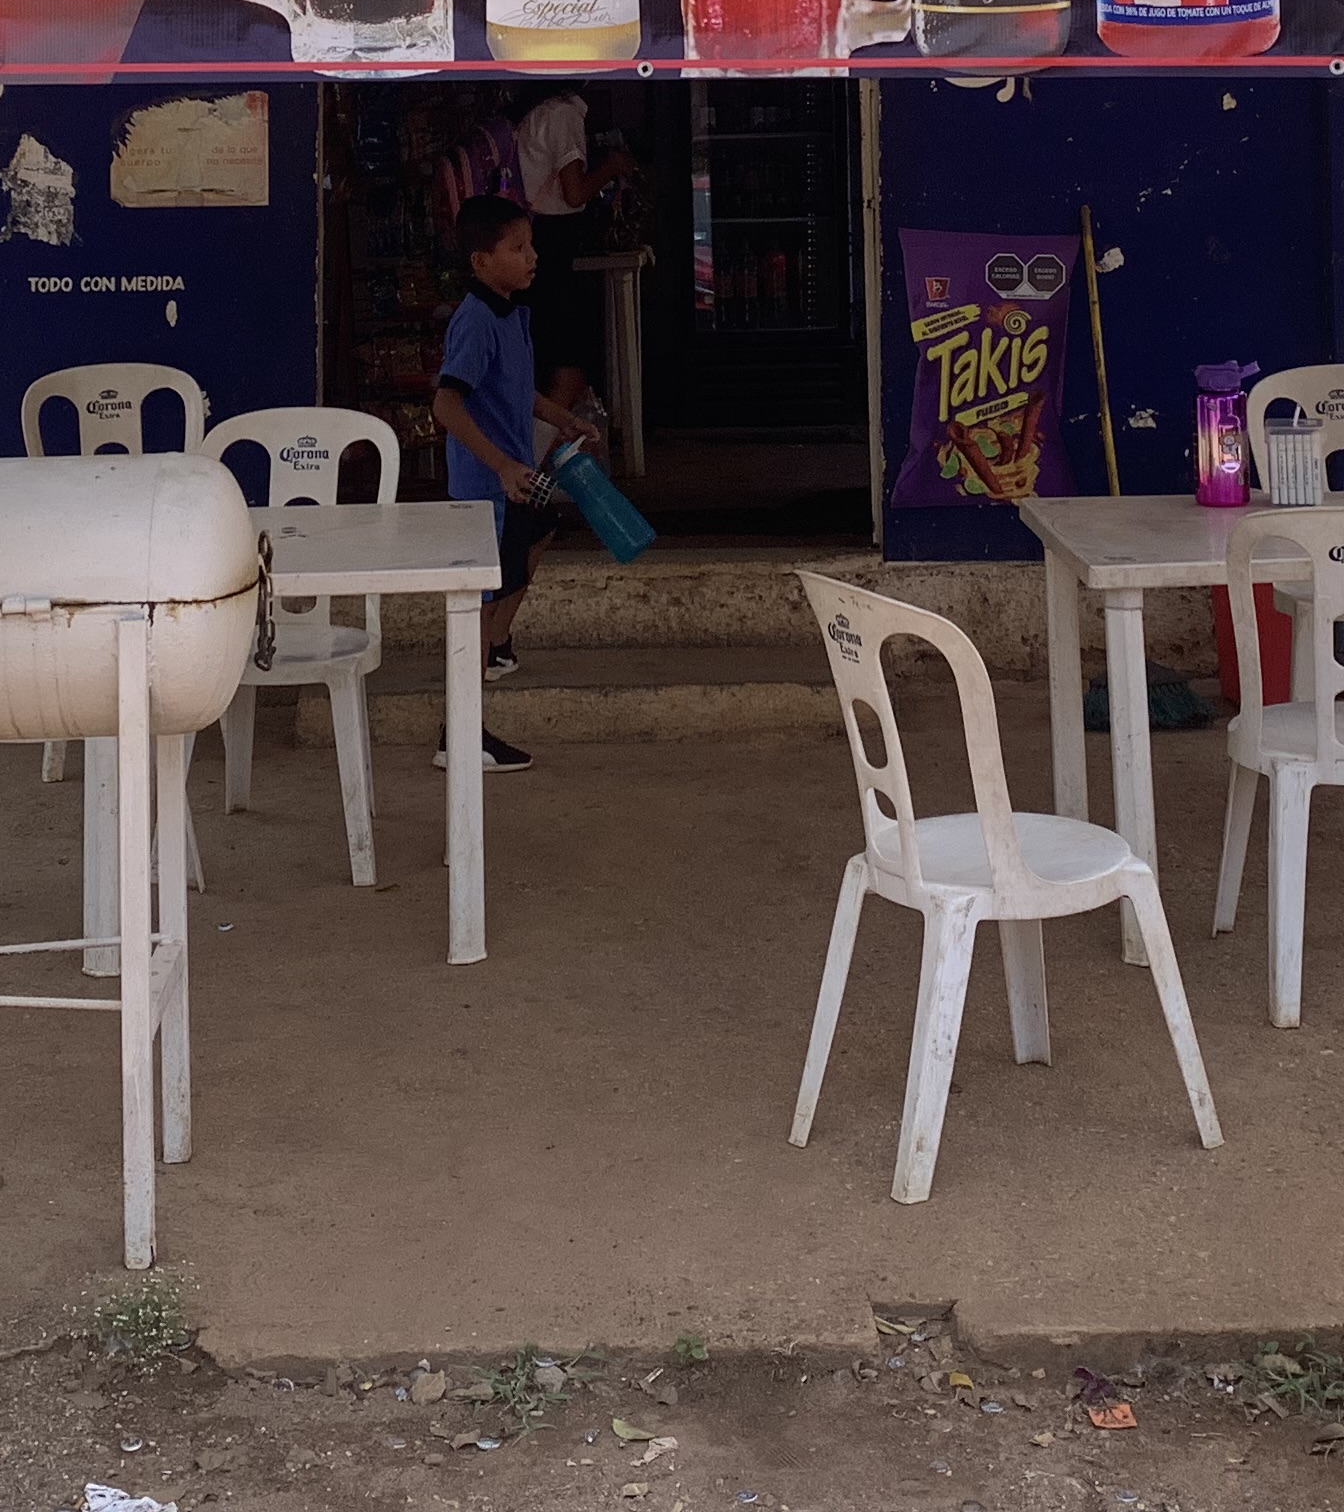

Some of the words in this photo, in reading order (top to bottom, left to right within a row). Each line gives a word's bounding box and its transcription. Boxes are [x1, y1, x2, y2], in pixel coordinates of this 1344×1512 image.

[1139, 8, 1148, 17] DE
[1149, 8, 1165, 18] JUGO
[1167, 8, 1177, 18] DE
[1178, 8, 1204, 18] TOMATE
[1205, 6, 1219, 17] CON
[1221, 6, 1232, 16] UN
[1233, 3, 1254, 14] TOQUE
[28, 277, 73, 293] TODO
[80, 277, 116, 292] CON
[121, 276, 185, 292] MEDIDA
[927, 324, 1050, 422] Takis
[86, 400, 132, 414] Corona
[279, 447, 329, 463] Corona
[293, 461, 320, 470] Extra
